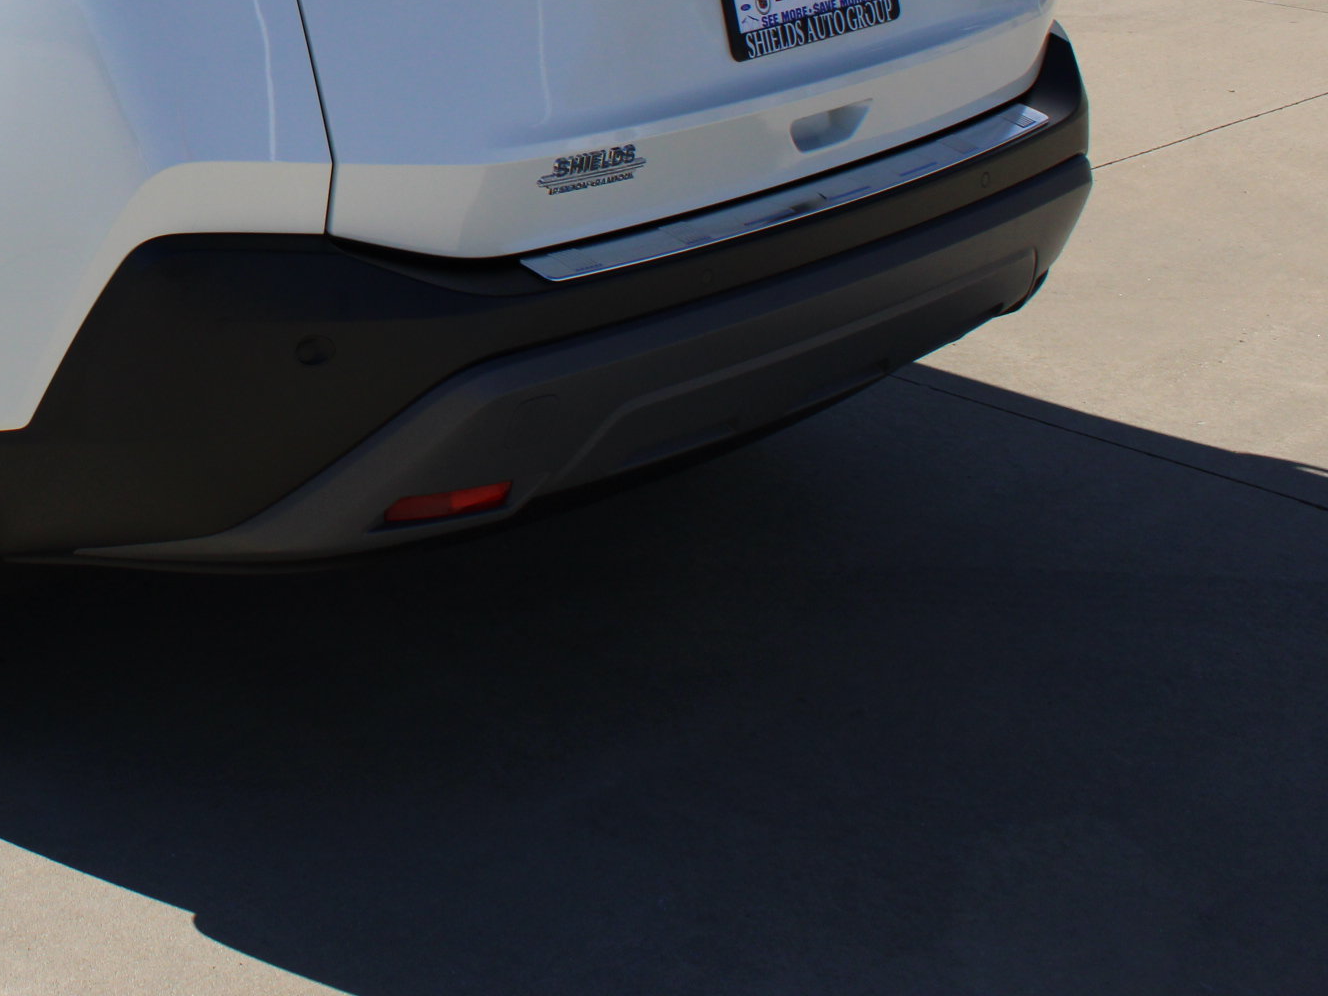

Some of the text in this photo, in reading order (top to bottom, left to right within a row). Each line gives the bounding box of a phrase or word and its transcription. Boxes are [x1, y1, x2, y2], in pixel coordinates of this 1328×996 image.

[761, 15, 780, 28] SEE
[781, 6, 809, 22] MORE
[744, 20, 806, 59] SHIELDS
[807, 9, 846, 43] AUTO
[553, 144, 636, 177] SHIELDS
